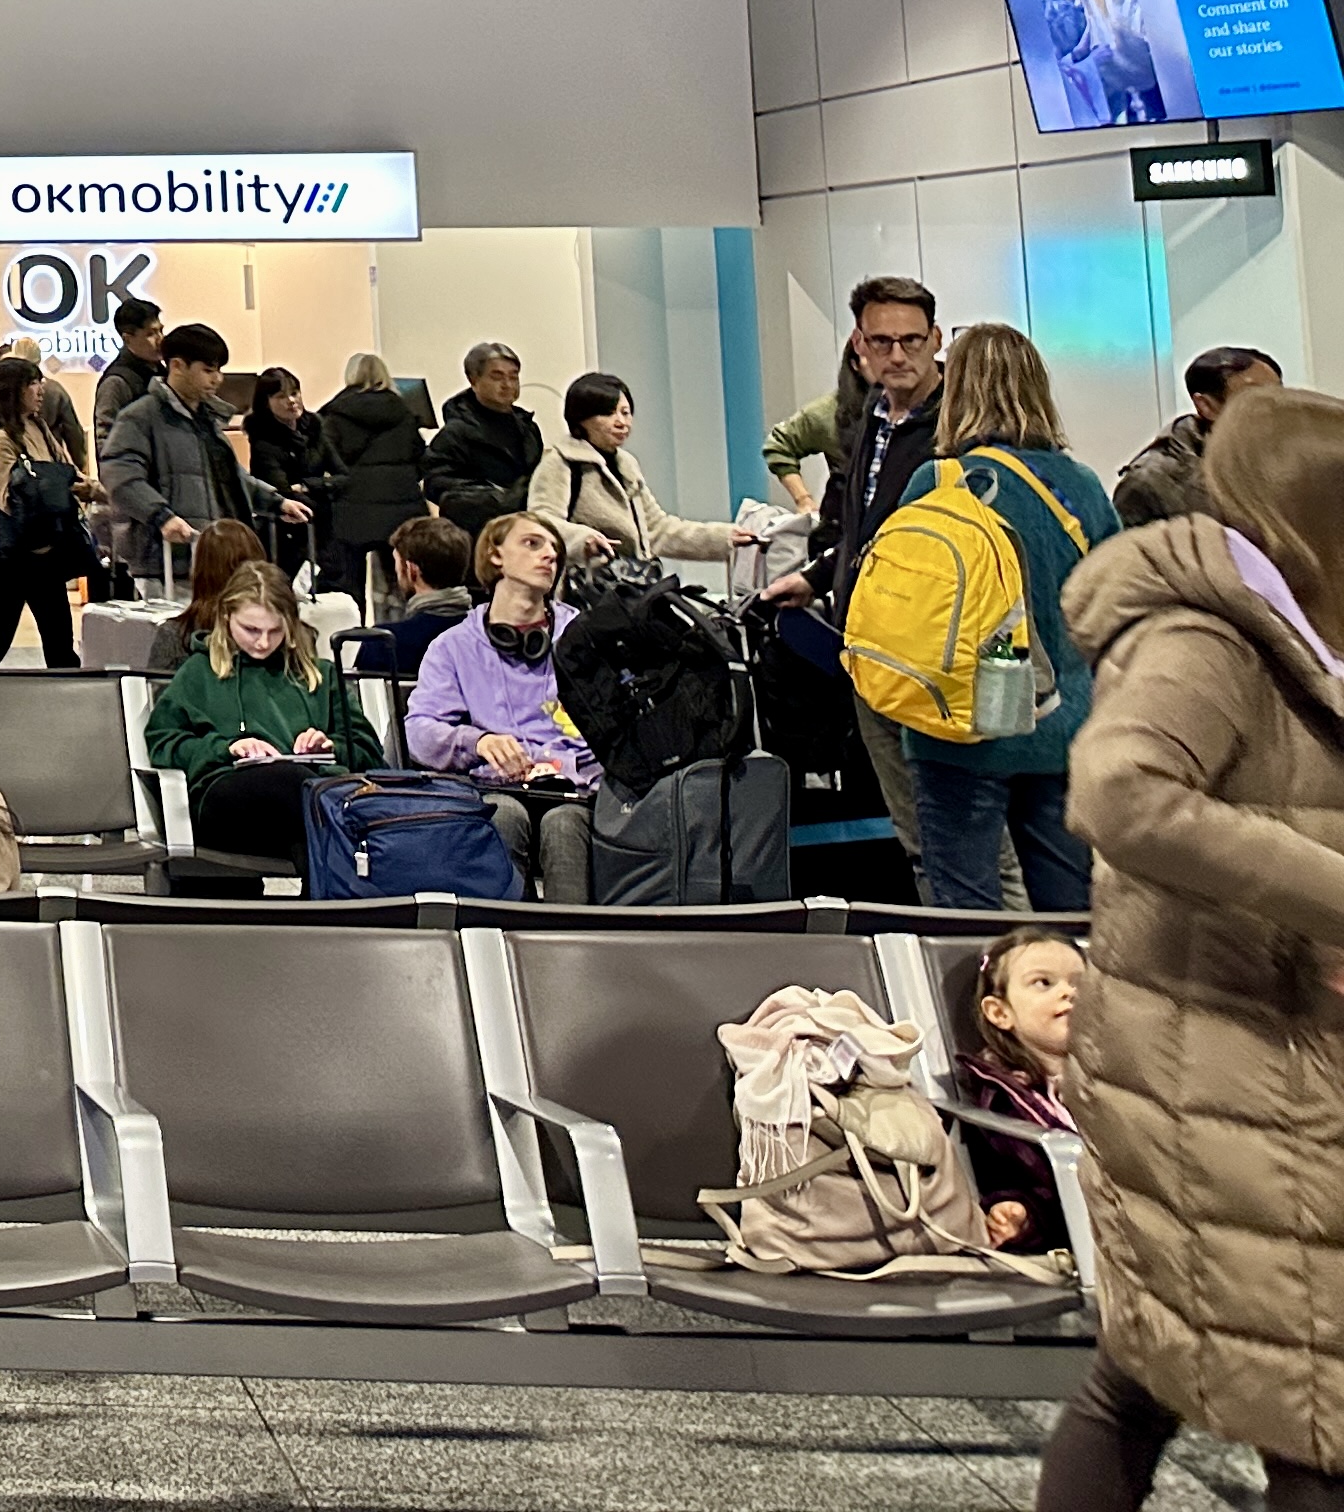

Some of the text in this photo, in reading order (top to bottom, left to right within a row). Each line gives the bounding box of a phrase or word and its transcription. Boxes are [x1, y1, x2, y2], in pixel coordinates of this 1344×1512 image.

[1204, 20, 1271, 38] and share
[1209, 38, 1283, 58] our stories
[1149, 157, 1248, 184] SAMSUNG
[7, 253, 151, 324] OK
